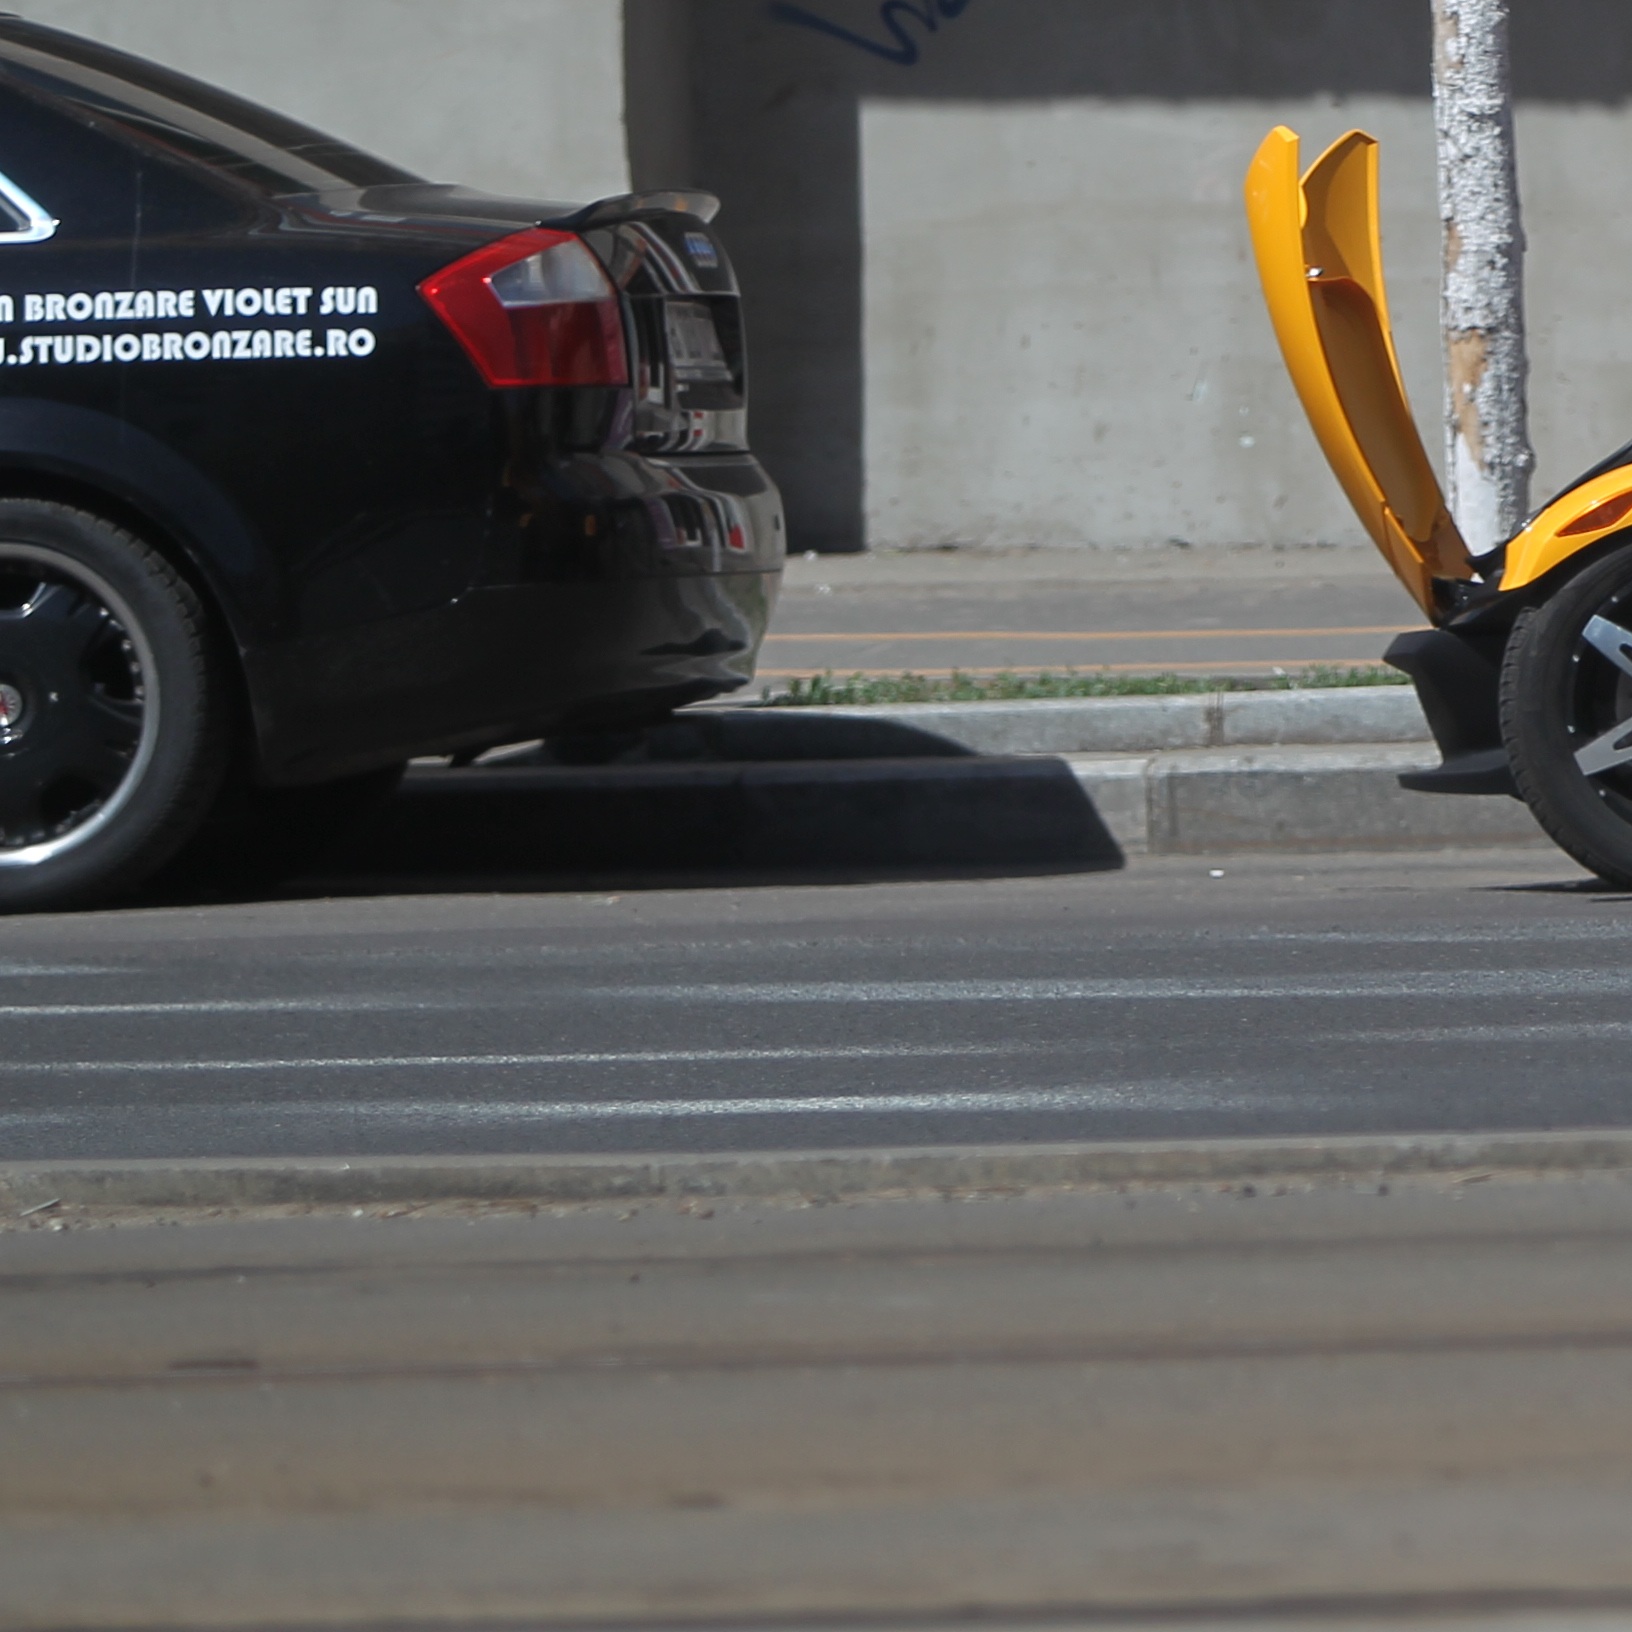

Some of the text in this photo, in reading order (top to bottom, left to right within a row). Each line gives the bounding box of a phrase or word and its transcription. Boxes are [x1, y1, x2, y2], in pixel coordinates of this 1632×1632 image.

[24, 289, 195, 322] BRONZARE
[202, 287, 313, 317] VIOLET
[319, 286, 378, 316] SUN
